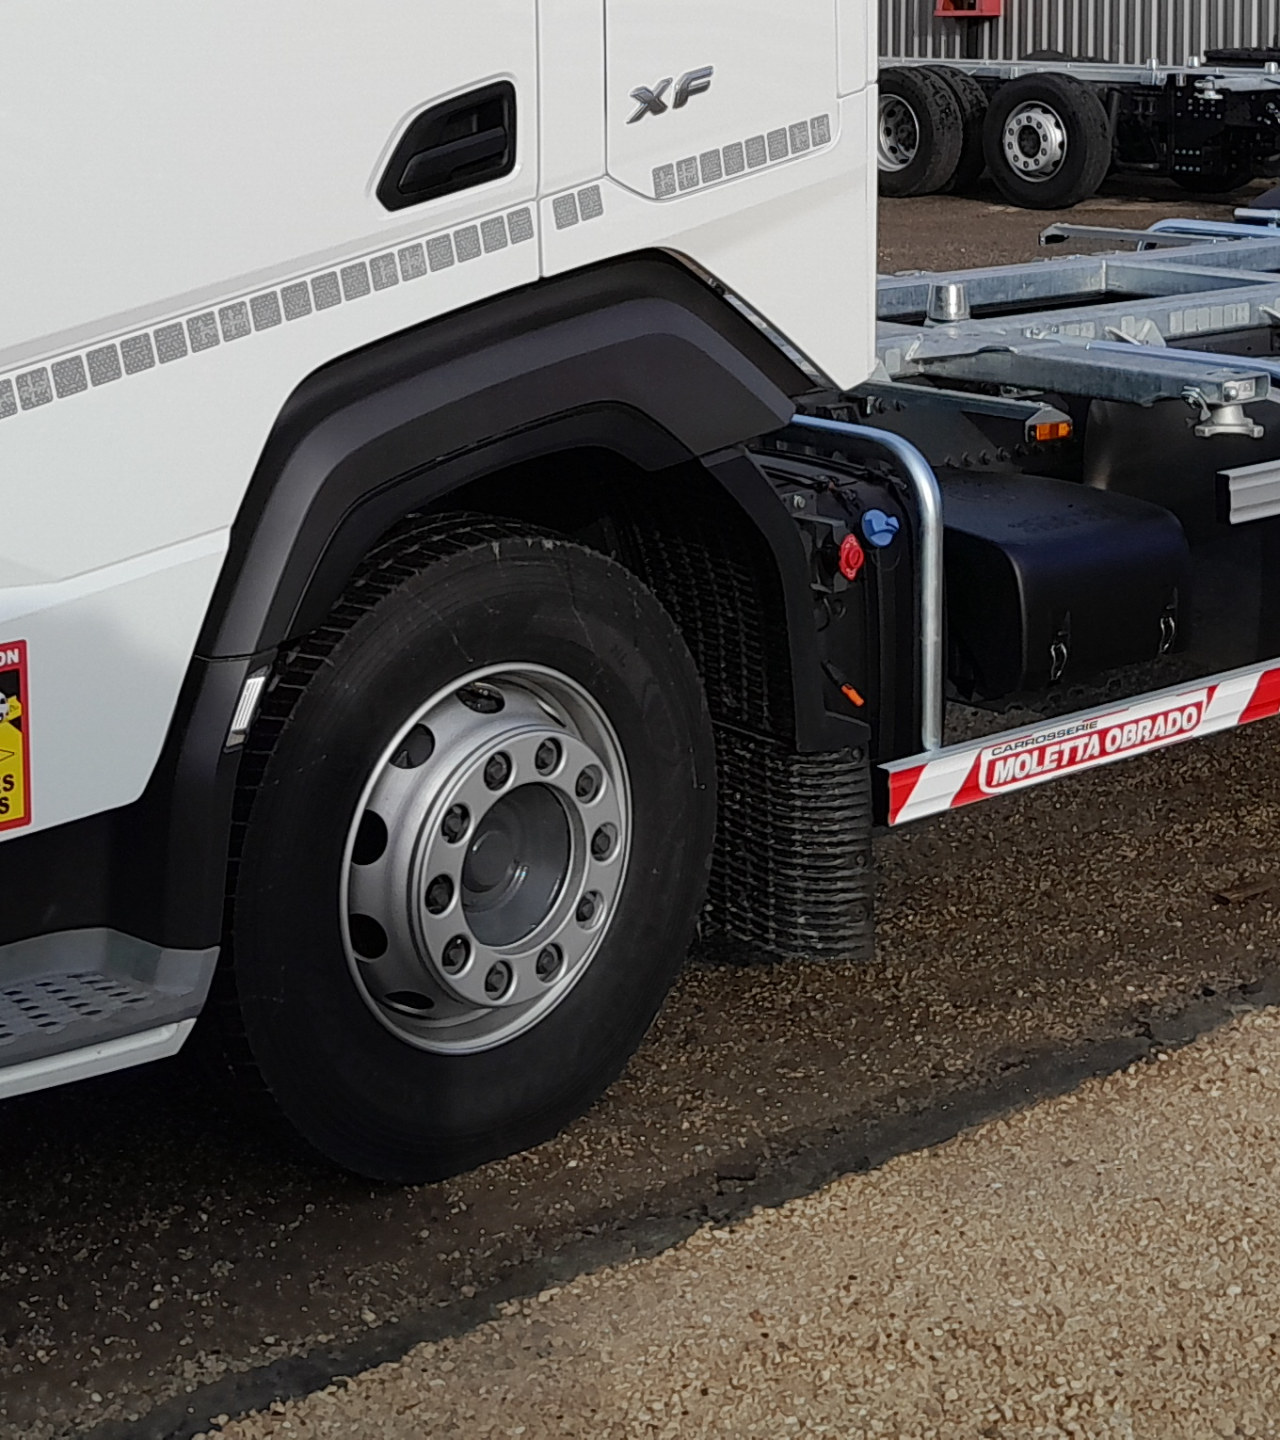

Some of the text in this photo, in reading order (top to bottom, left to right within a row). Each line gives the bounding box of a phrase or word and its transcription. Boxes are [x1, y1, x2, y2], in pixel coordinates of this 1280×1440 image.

[625, 64, 714, 125] XF
[990, 706, 1199, 786] MOLETTA OBRADO
[991, 720, 1099, 757] CARROSSERIE
